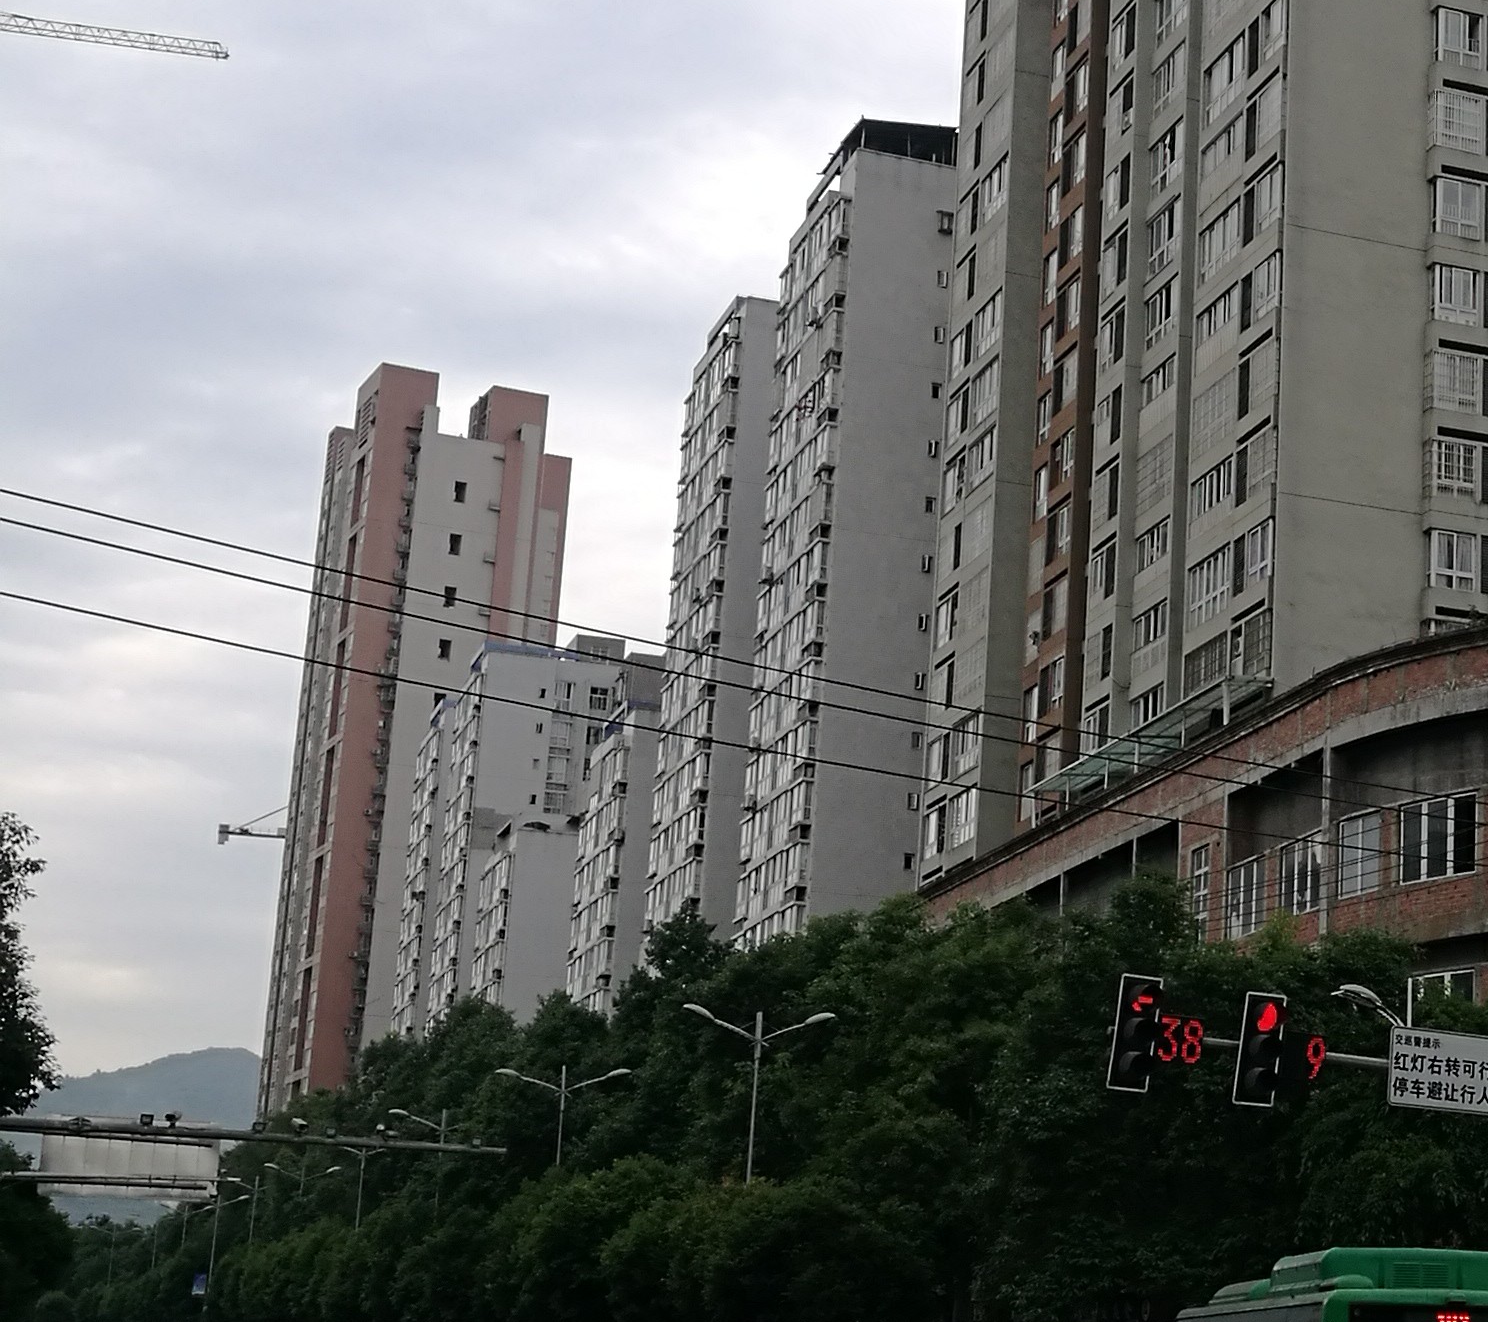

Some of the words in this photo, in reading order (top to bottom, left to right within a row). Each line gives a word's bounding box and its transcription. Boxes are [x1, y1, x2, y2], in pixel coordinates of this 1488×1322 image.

[1157, 1015, 1204, 1064] 38
[1306, 1035, 1327, 1080] 9
[1395, 1034, 1441, 1050] 交巡警提示
